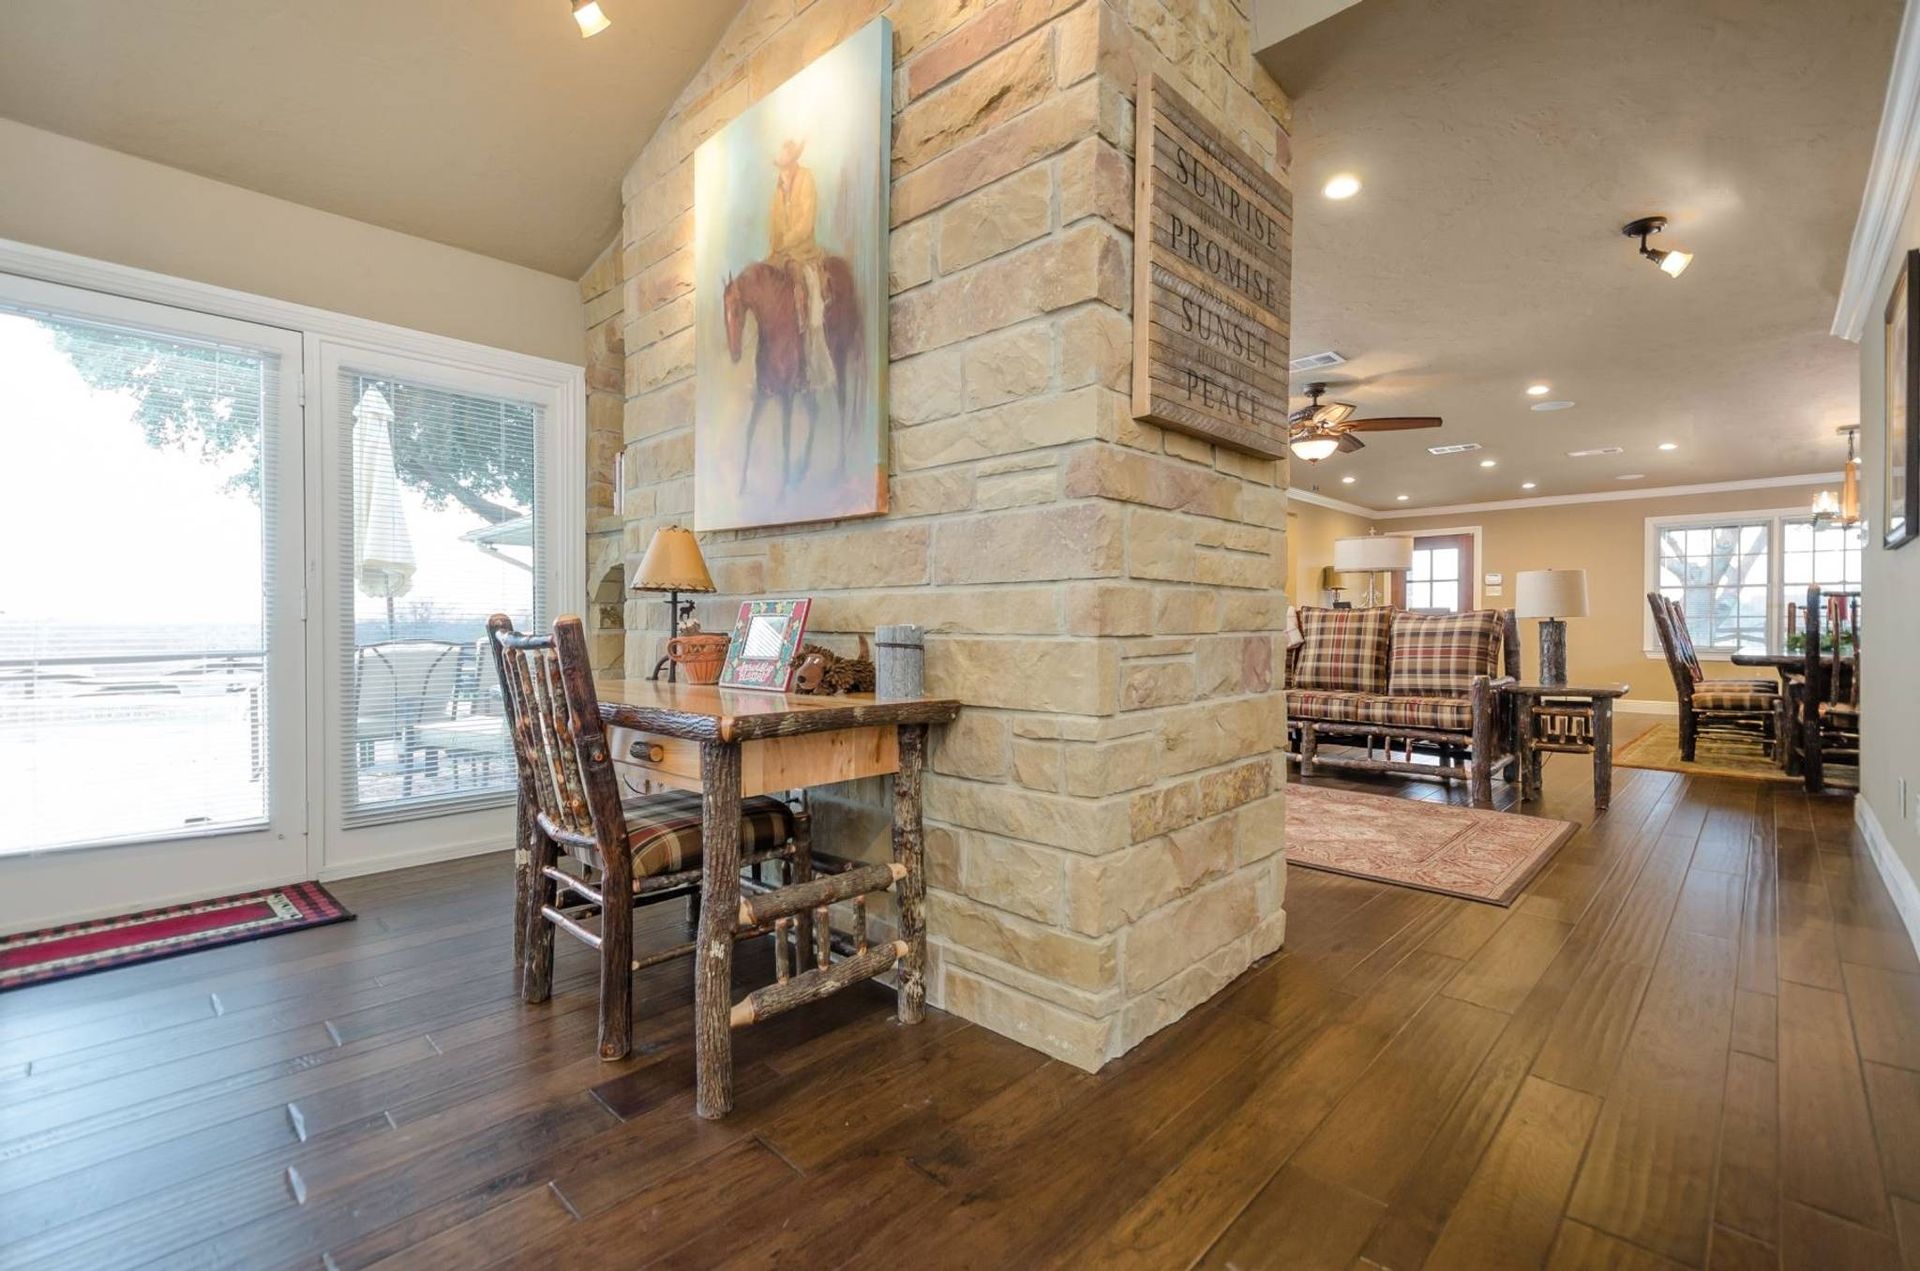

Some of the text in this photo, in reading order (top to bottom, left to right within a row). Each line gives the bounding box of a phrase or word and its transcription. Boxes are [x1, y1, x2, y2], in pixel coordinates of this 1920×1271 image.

[1176, 147, 1277, 249] SUNRISE
[1170, 213, 1277, 309] PROMISE
[1181, 297, 1270, 368] SUNSET
[1186, 368, 1261, 426] PEACE
